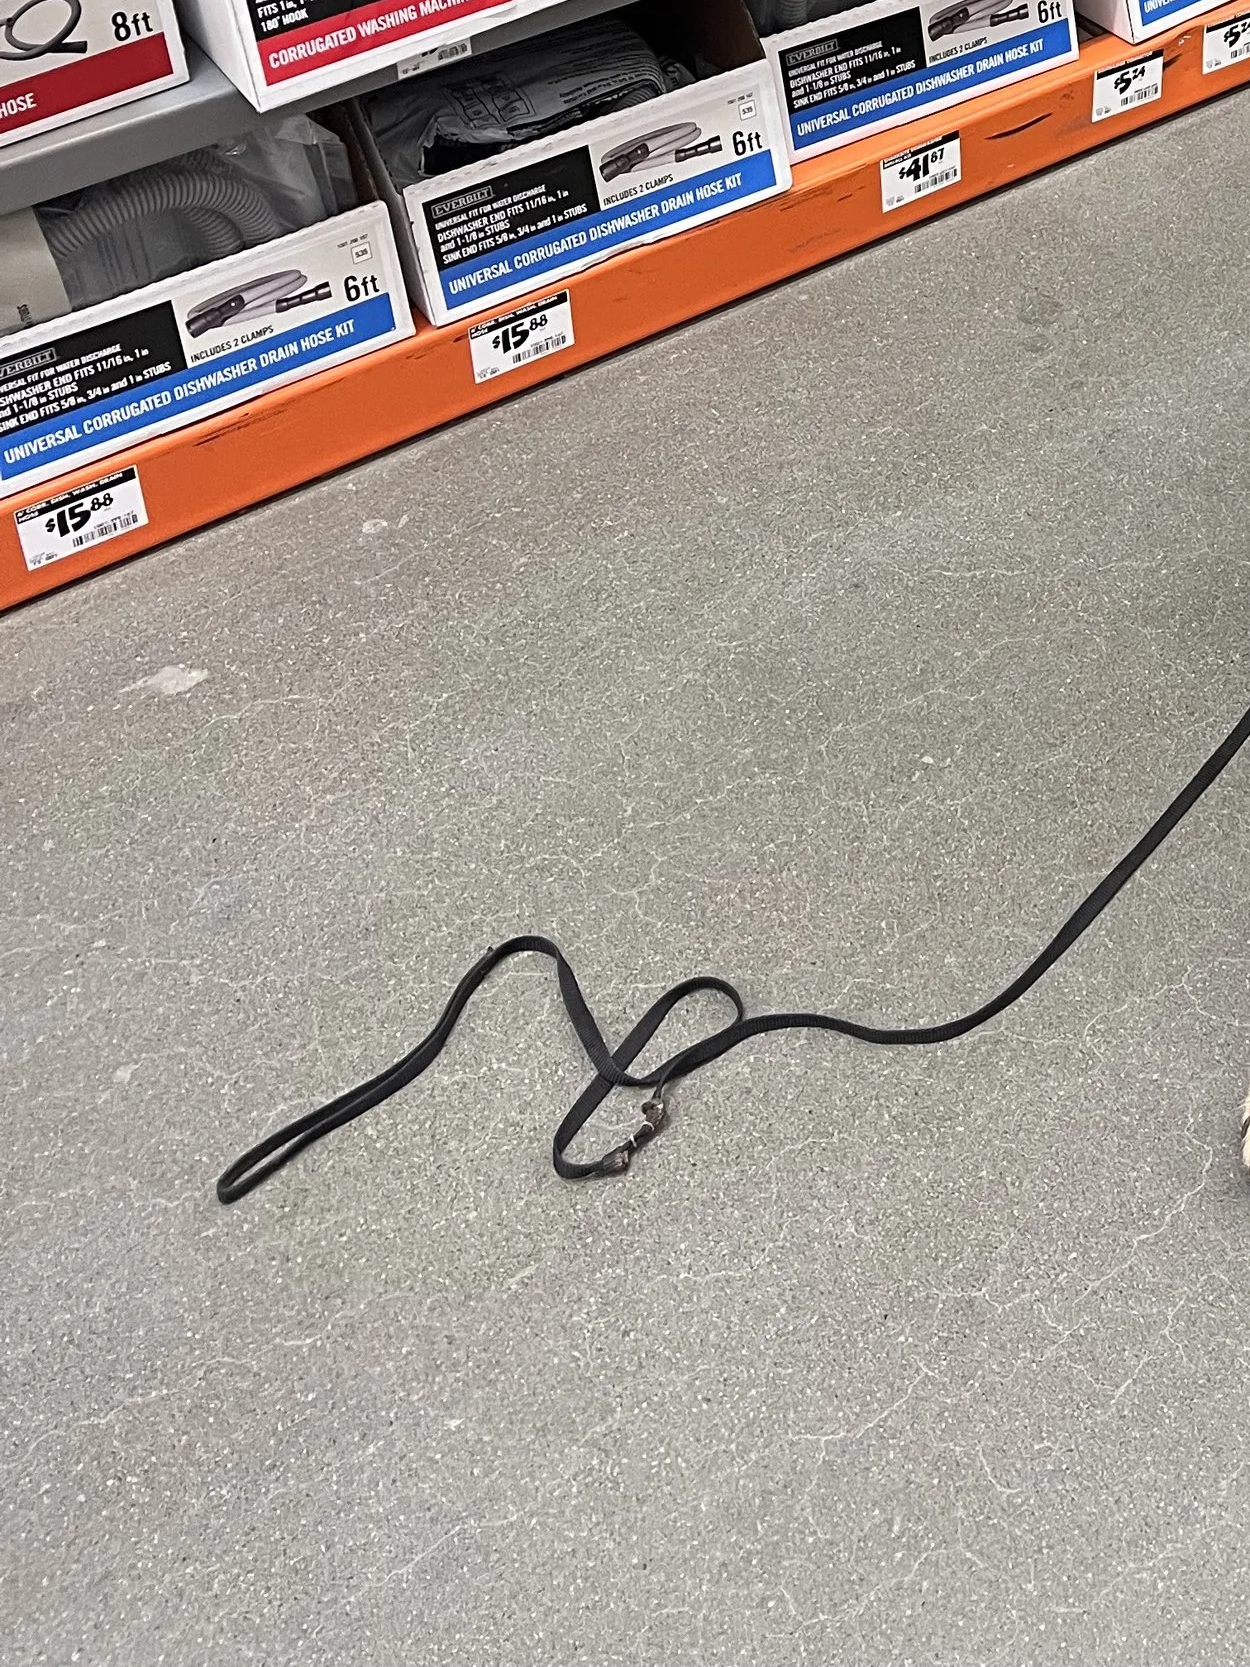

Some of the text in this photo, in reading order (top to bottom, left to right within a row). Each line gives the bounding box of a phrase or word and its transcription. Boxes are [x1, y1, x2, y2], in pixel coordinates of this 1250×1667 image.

[112, 10, 155, 43] 8ft
[257, 2, 278, 18] FITS
[283, 9, 309, 27] HOOK
[1037, 0, 1063, 24] 6ft
[268, 27, 357, 69] CORRUGATED
[357, 6, 417, 38] WASHING
[797, 38, 1045, 137] UNIVERSAL CORRUGATED DISHWASHER DRAIN HOSE KIT
[732, 130, 763, 156] 6ft
[433, 187, 490, 217] EVERBILT
[603, 187, 638, 207] INCLUDES
[645, 174, 674, 191] CLAMPS
[448, 172, 742, 295] UNIVERSAL CORRUGATED DISHWASHER DRAIN HOSE KIT
[343, 274, 380, 302] 6ft
[190, 342, 232, 363] INCLUDES
[240, 324, 275, 345] CLAMPS
[4, 318, 356, 465] UNIVERSAL CORRUGATED DISHWASHER DRAIN HOSE KIT
